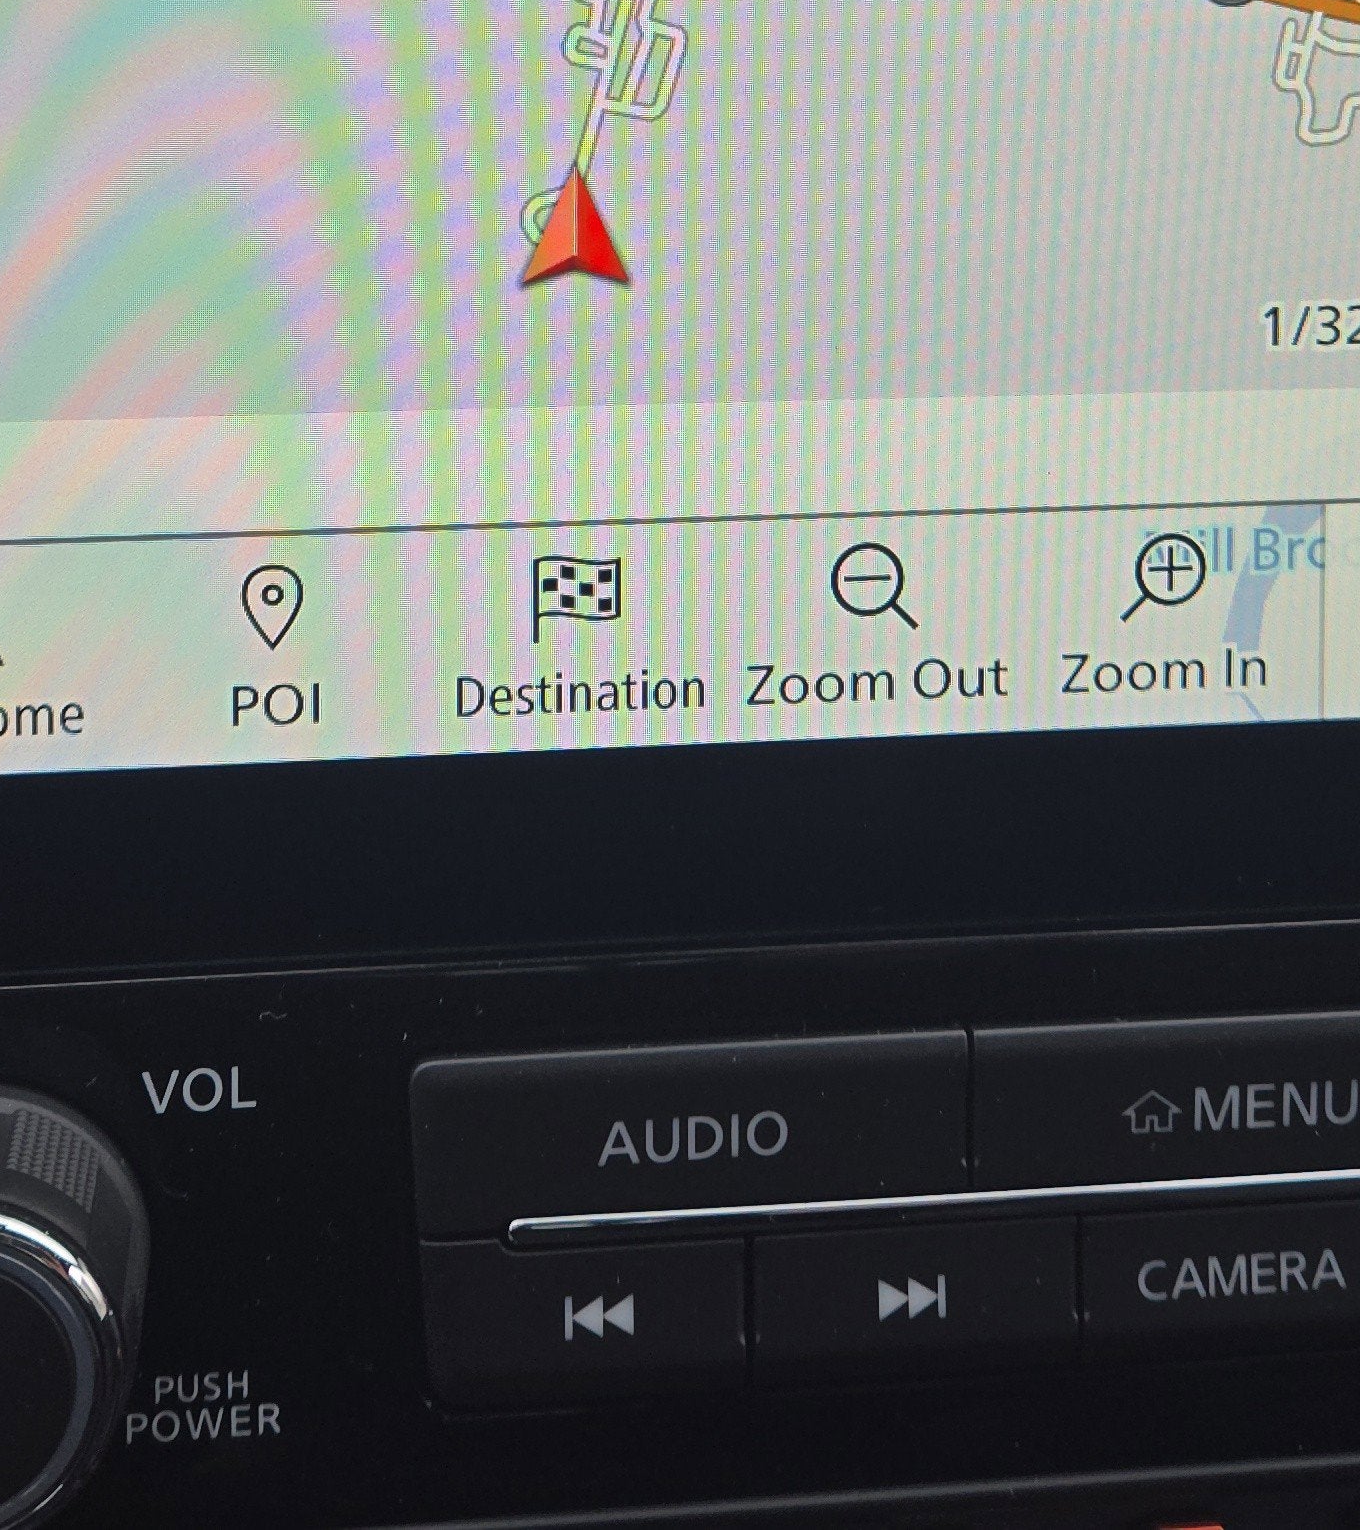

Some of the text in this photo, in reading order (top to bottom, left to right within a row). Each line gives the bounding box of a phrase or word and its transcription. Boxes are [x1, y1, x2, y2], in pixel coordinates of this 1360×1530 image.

[453, 668, 708, 720] Destination
[744, 656, 1010, 708] Zoom Out
[1059, 646, 1268, 697] Zoom In
[230, 681, 323, 727] POI
[140, 1067, 257, 1115] VOL
[1190, 1079, 1360, 1132] MENU
[597, 1110, 789, 1167] AUDIO
[1135, 1249, 1347, 1301] CAMERA
[154, 1371, 251, 1405] PUSH
[125, 1403, 281, 1446] POWER
